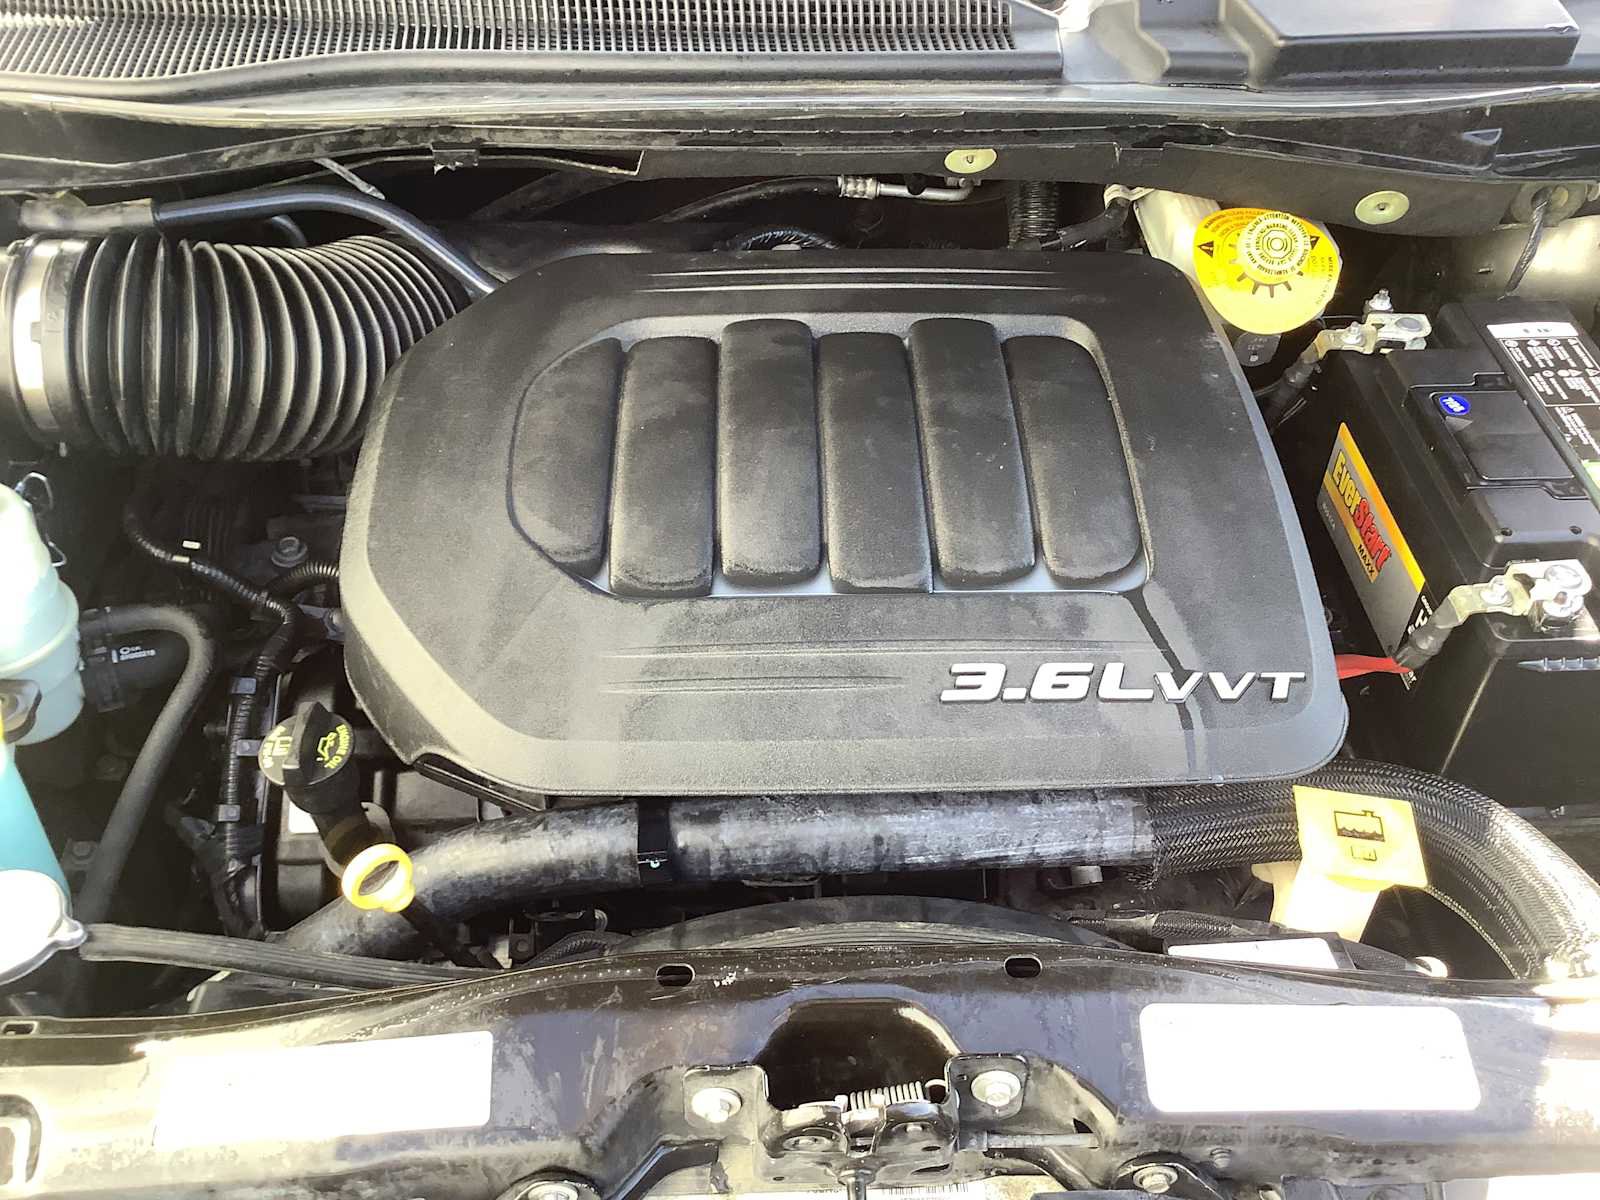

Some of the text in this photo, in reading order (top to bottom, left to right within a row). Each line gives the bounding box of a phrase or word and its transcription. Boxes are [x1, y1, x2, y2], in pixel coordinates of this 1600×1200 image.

[1357, 543, 1376, 576] MAXX
[940, 662, 1307, 704] 3.6L VVT
[324, 755, 342, 769] OIL
